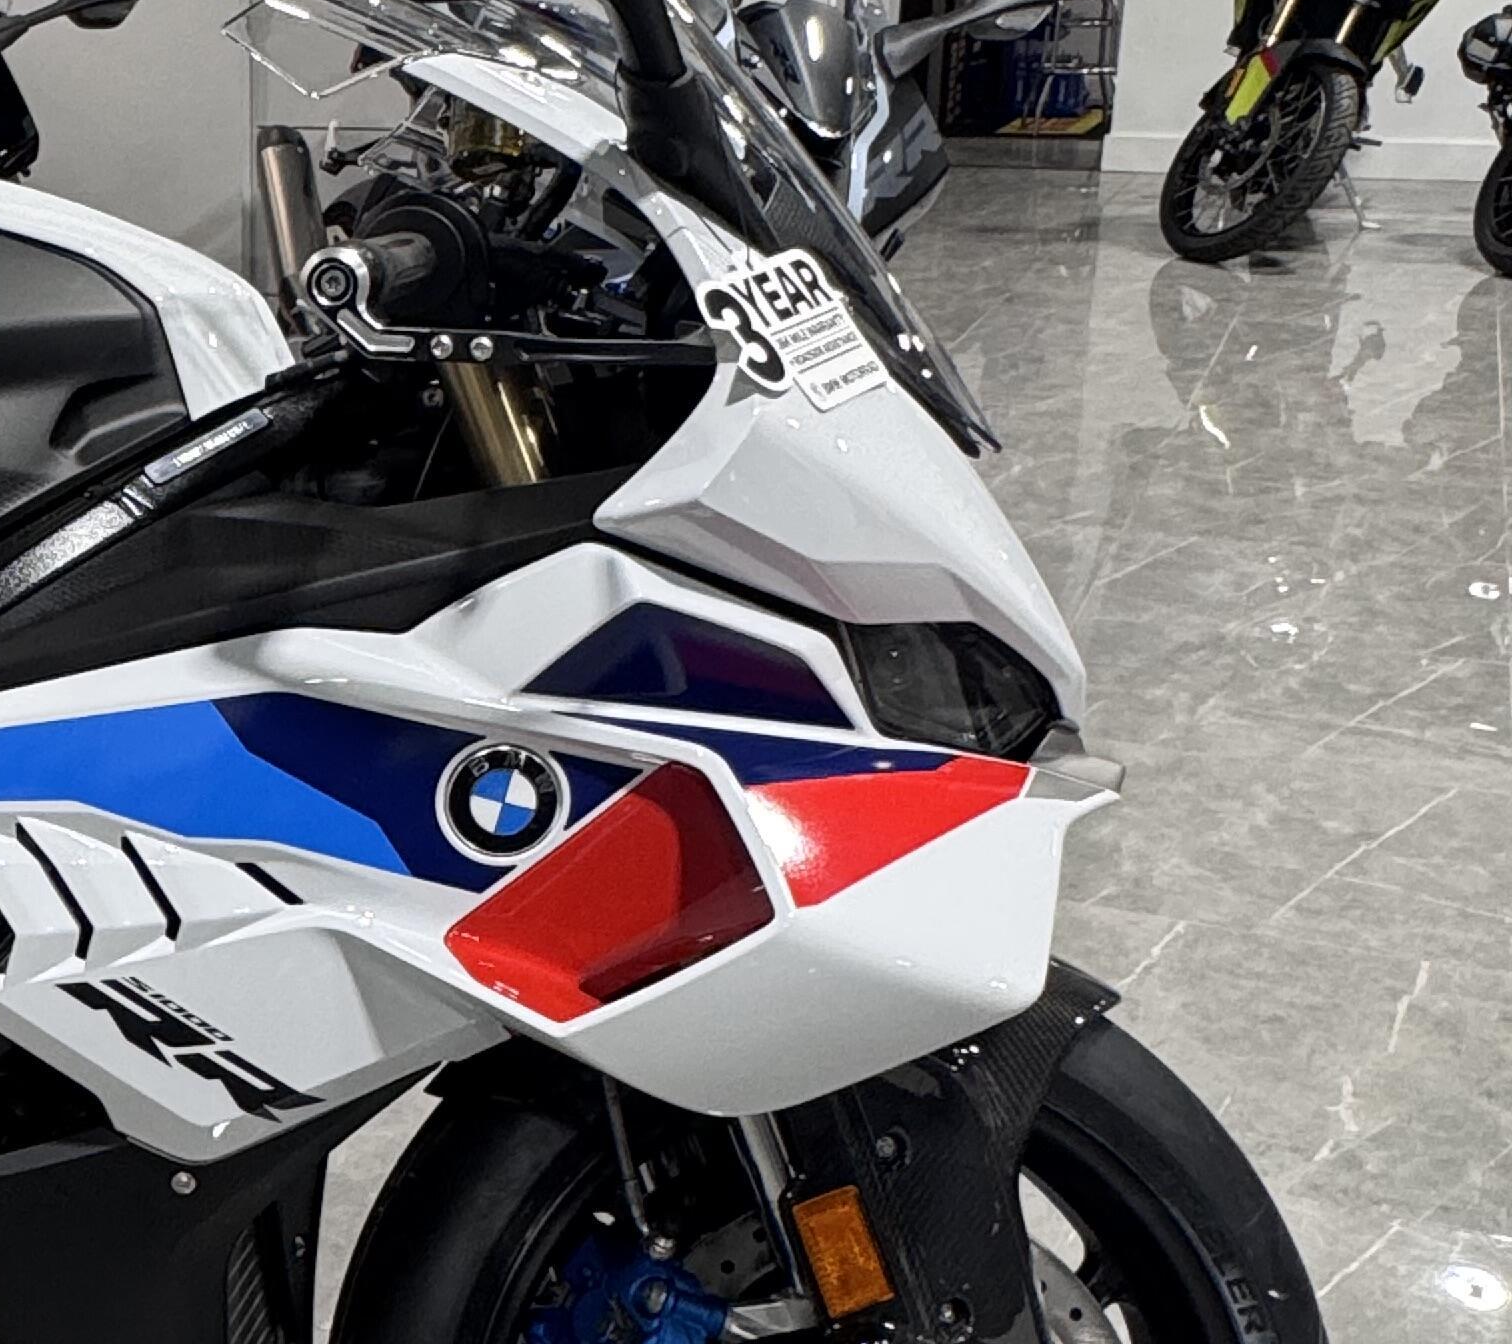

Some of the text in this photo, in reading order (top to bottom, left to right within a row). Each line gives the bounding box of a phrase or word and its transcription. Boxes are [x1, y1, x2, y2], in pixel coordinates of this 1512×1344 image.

[704, 258, 833, 383] 3 YEAR
[467, 749, 556, 794] BMW
[54, 978, 327, 1124] RR
